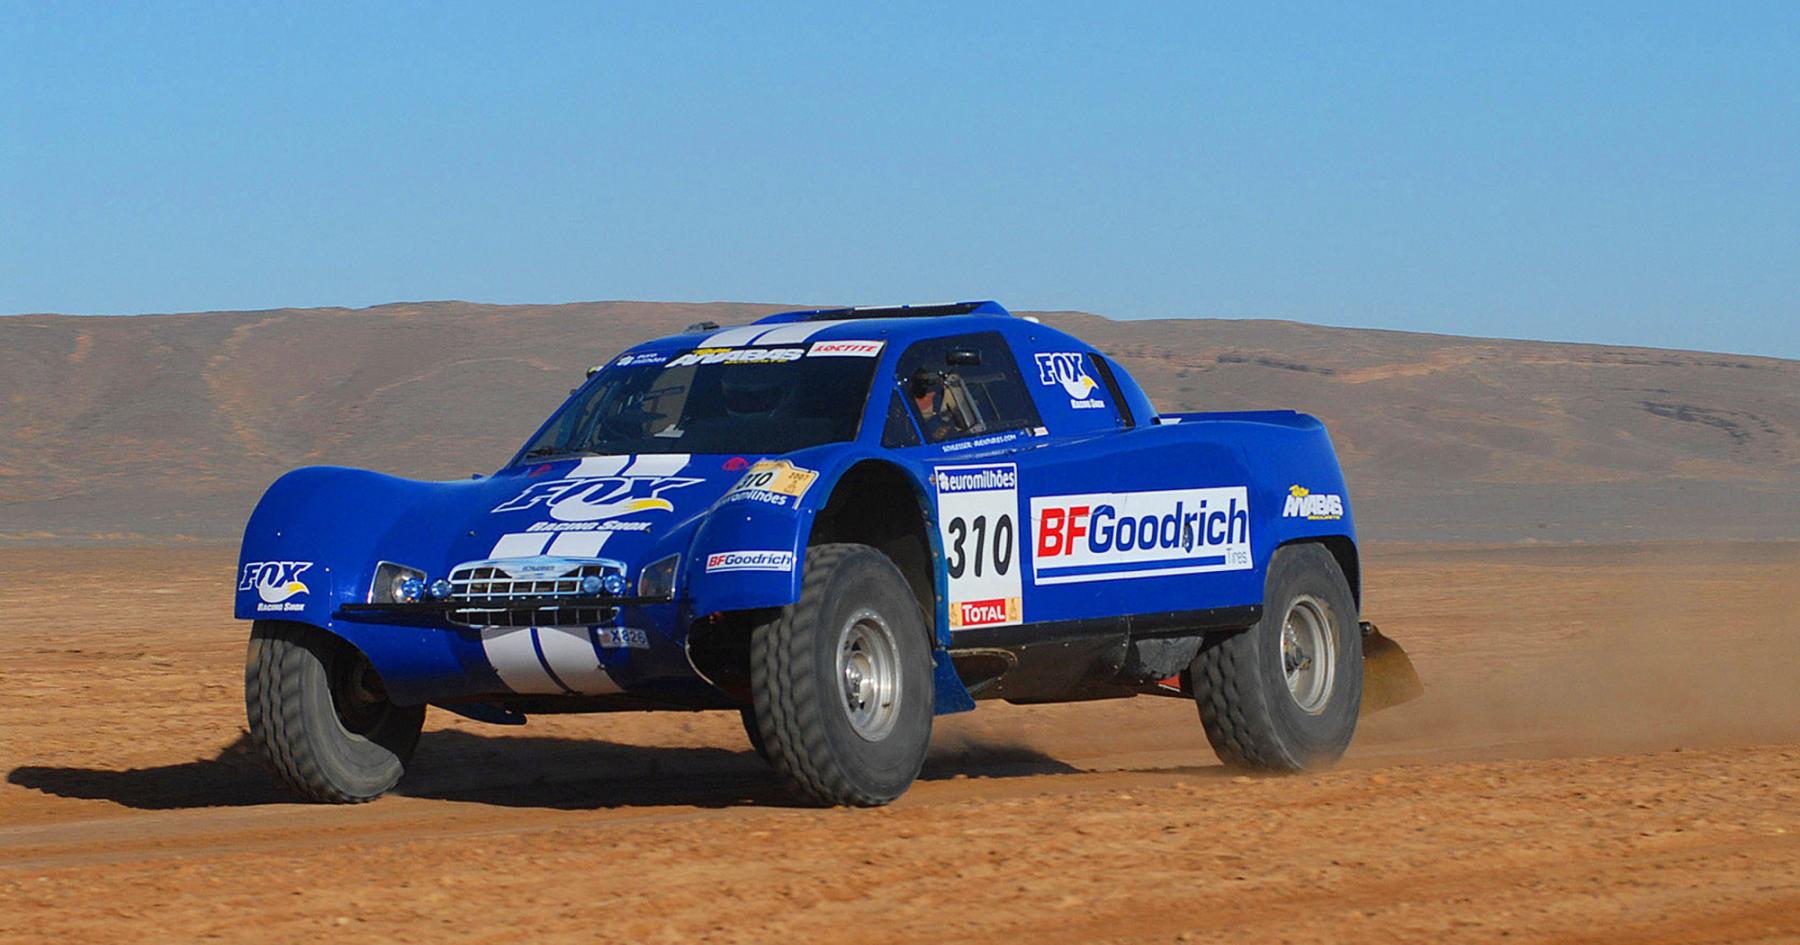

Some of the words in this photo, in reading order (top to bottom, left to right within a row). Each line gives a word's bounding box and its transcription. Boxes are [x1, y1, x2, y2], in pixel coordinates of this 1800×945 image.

[815, 344, 878, 352] LOCTITE
[1034, 353, 1084, 385] FOX
[950, 470, 1015, 490] euromilhões
[490, 477, 706, 513] FOX
[526, 522, 599, 532] RACING
[1037, 498, 1247, 558] BFGoodrich
[947, 513, 1013, 579] 310
[1226, 547, 1247, 564] Tires
[709, 554, 790, 567] BFGoodrich
[239, 561, 313, 591] FOX
[962, 604, 1005, 622] TOTAL
